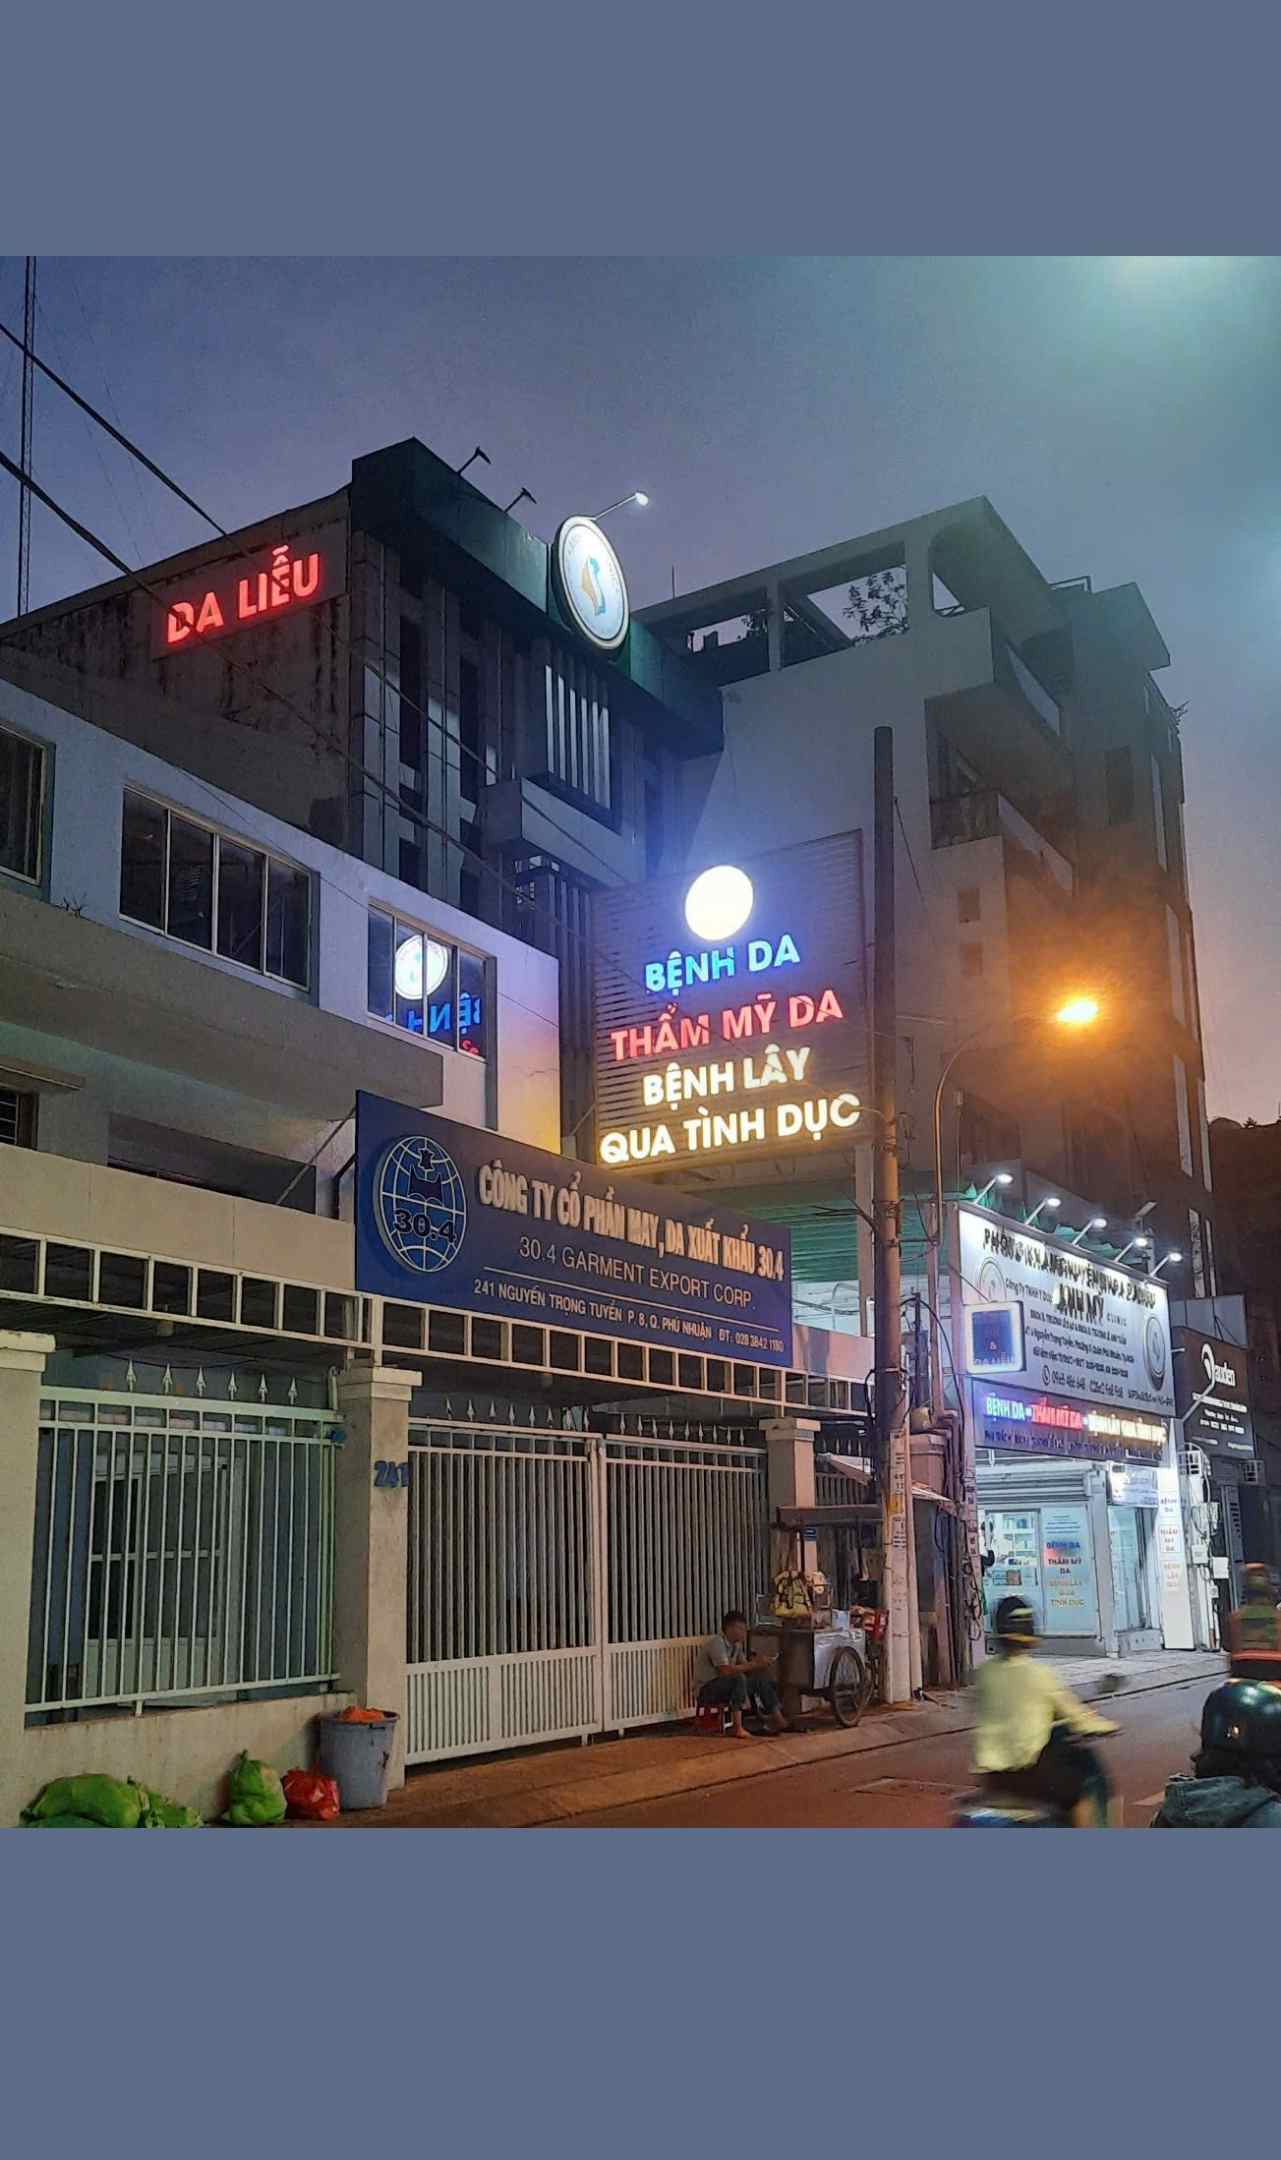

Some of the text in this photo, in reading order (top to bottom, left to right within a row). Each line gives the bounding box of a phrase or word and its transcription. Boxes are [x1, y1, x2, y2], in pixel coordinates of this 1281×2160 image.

[167, 544, 319, 643] DA LIỄU
[644, 934, 800, 995] BỆNH DA
[610, 989, 843, 1061] THẨM MỸ DA
[643, 1043, 810, 1110] BỆNH LÂY
[599, 1092, 861, 1164] QUA TÌNH DỤC
[394, 1209, 455, 1243] 30.4
[479, 1159, 528, 1215] CÔNG
[531, 1179, 555, 1221] TY
[557, 1170, 581, 1228] CỔ
[665, 1218, 685, 1257] DA
[757, 1245, 784, 1281] 30.4
[474, 1278, 495, 1297] 241
[549, 1294, 586, 1316] TRỌNG
[519, 1236, 556, 1264] 30.4
[561, 1246, 645, 1285] GARMENT
[650, 1268, 710, 1302] EXPORT
